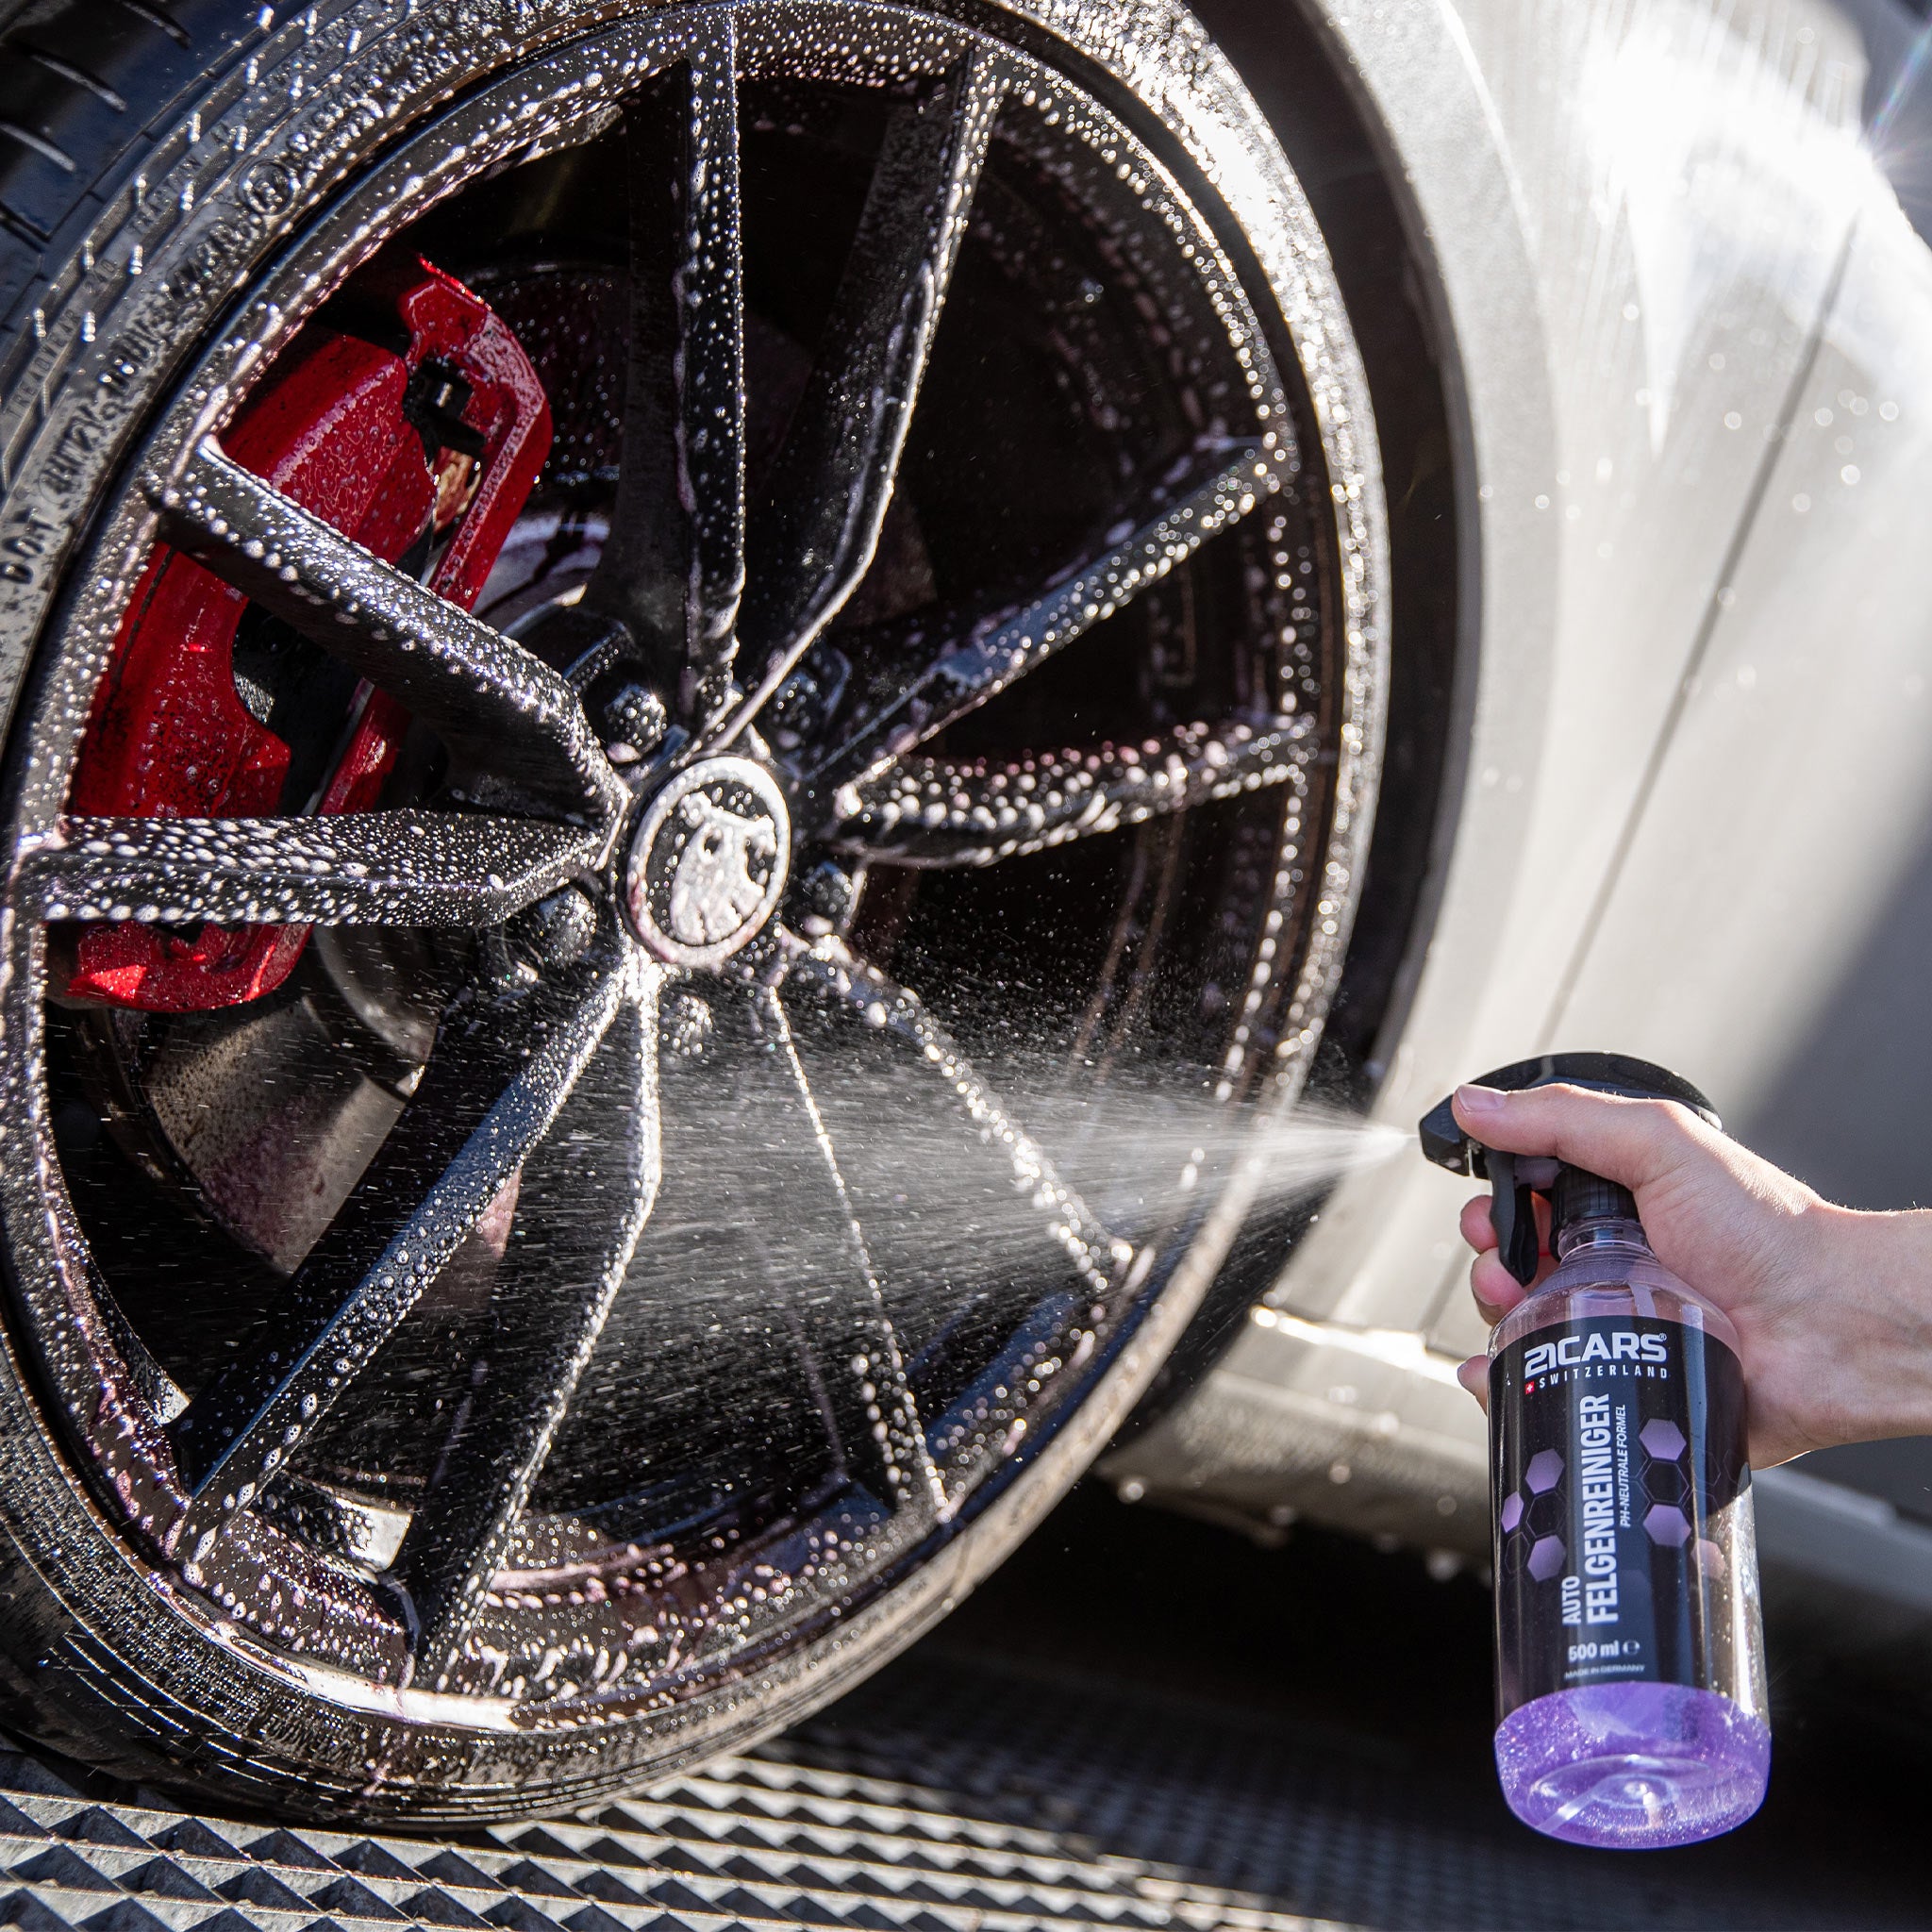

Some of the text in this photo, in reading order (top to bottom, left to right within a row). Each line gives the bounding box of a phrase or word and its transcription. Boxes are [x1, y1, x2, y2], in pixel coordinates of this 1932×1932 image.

[3, 308, 83, 419] TREADWEAR
[1540, 1364, 1668, 1389] SWITZERLAND
[1615, 1405, 1631, 1528] PH-NEUTRALE FORMEL
[1579, 1393, 1619, 1624] FELGENREINIGER
[1561, 1575, 1581, 1624] AUTO
[1568, 1640, 1619, 1662] 500 ml
